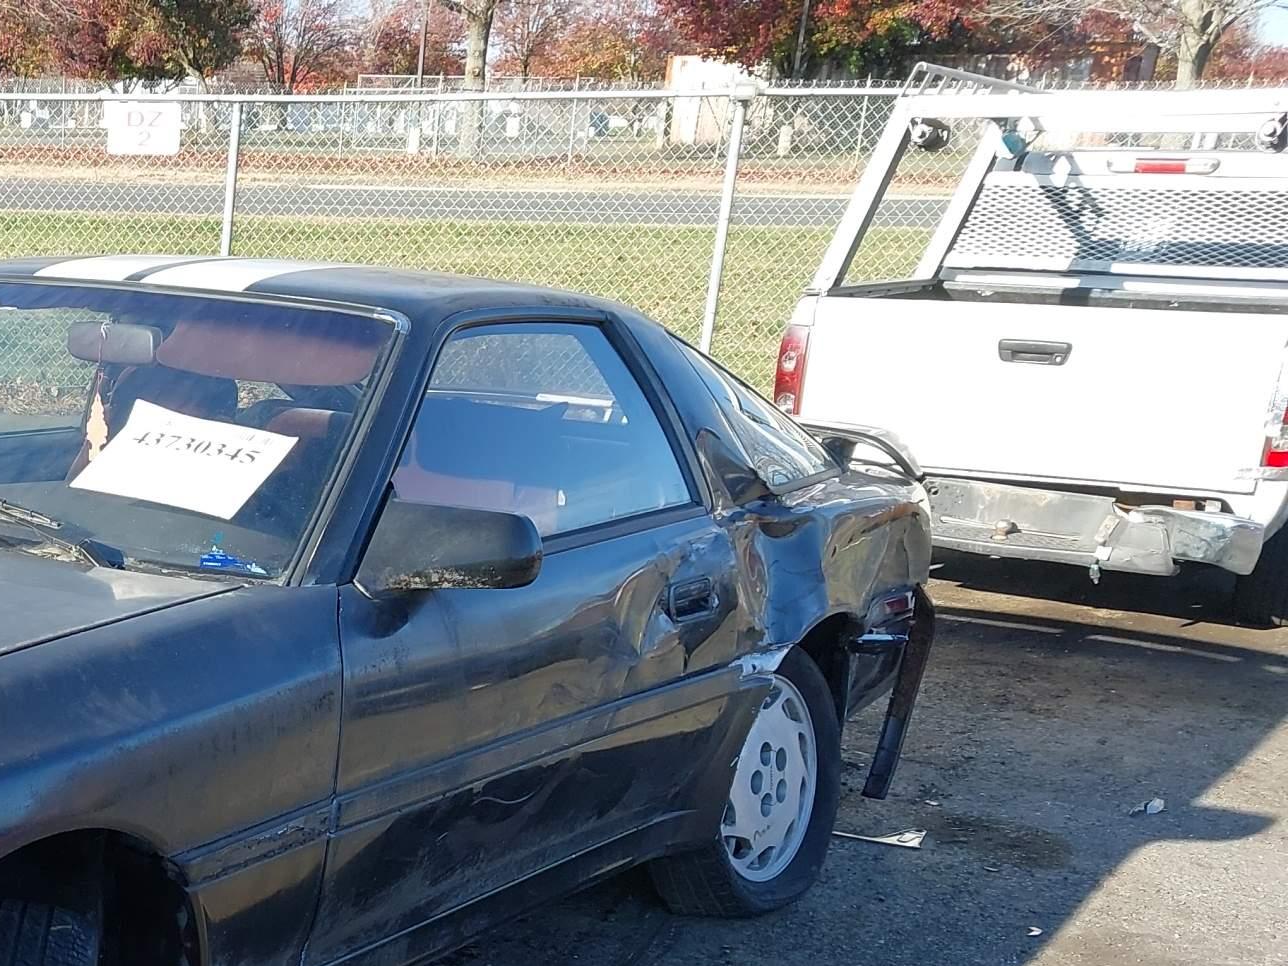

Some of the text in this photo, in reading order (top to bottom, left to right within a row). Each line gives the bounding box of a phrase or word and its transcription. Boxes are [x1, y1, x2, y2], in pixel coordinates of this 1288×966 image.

[127, 110, 163, 127] DZ
[137, 130, 152, 147] 2
[133, 431, 261, 464] 43730345
